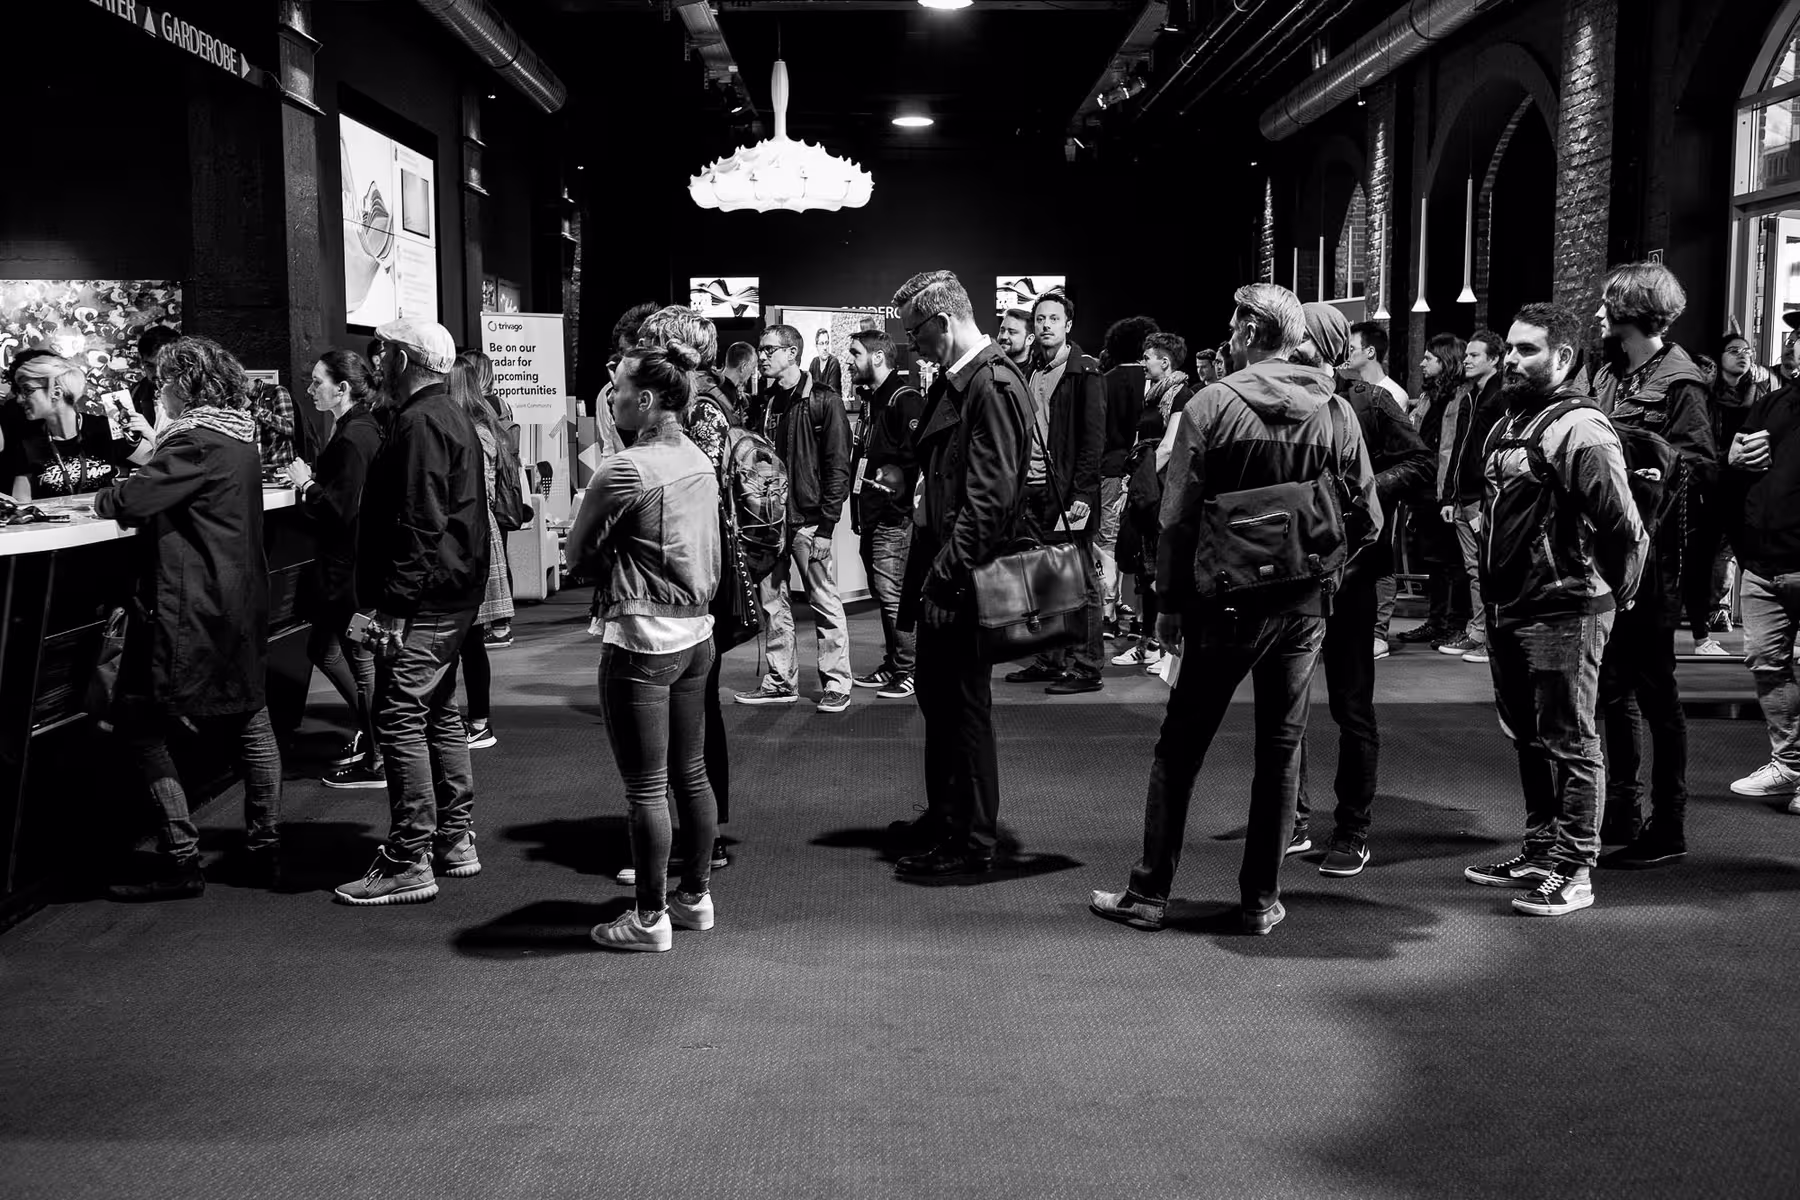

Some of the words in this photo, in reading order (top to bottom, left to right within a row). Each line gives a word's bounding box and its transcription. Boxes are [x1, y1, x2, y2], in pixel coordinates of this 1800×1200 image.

[161, 11, 238, 75] GARDEROBE
[498, 322, 523, 332] trivago
[489, 342, 503, 353] Be
[505, 344, 517, 353] on
[519, 344, 536, 353] our
[518, 356, 532, 366] for
[492, 385, 557, 397] opportunities
